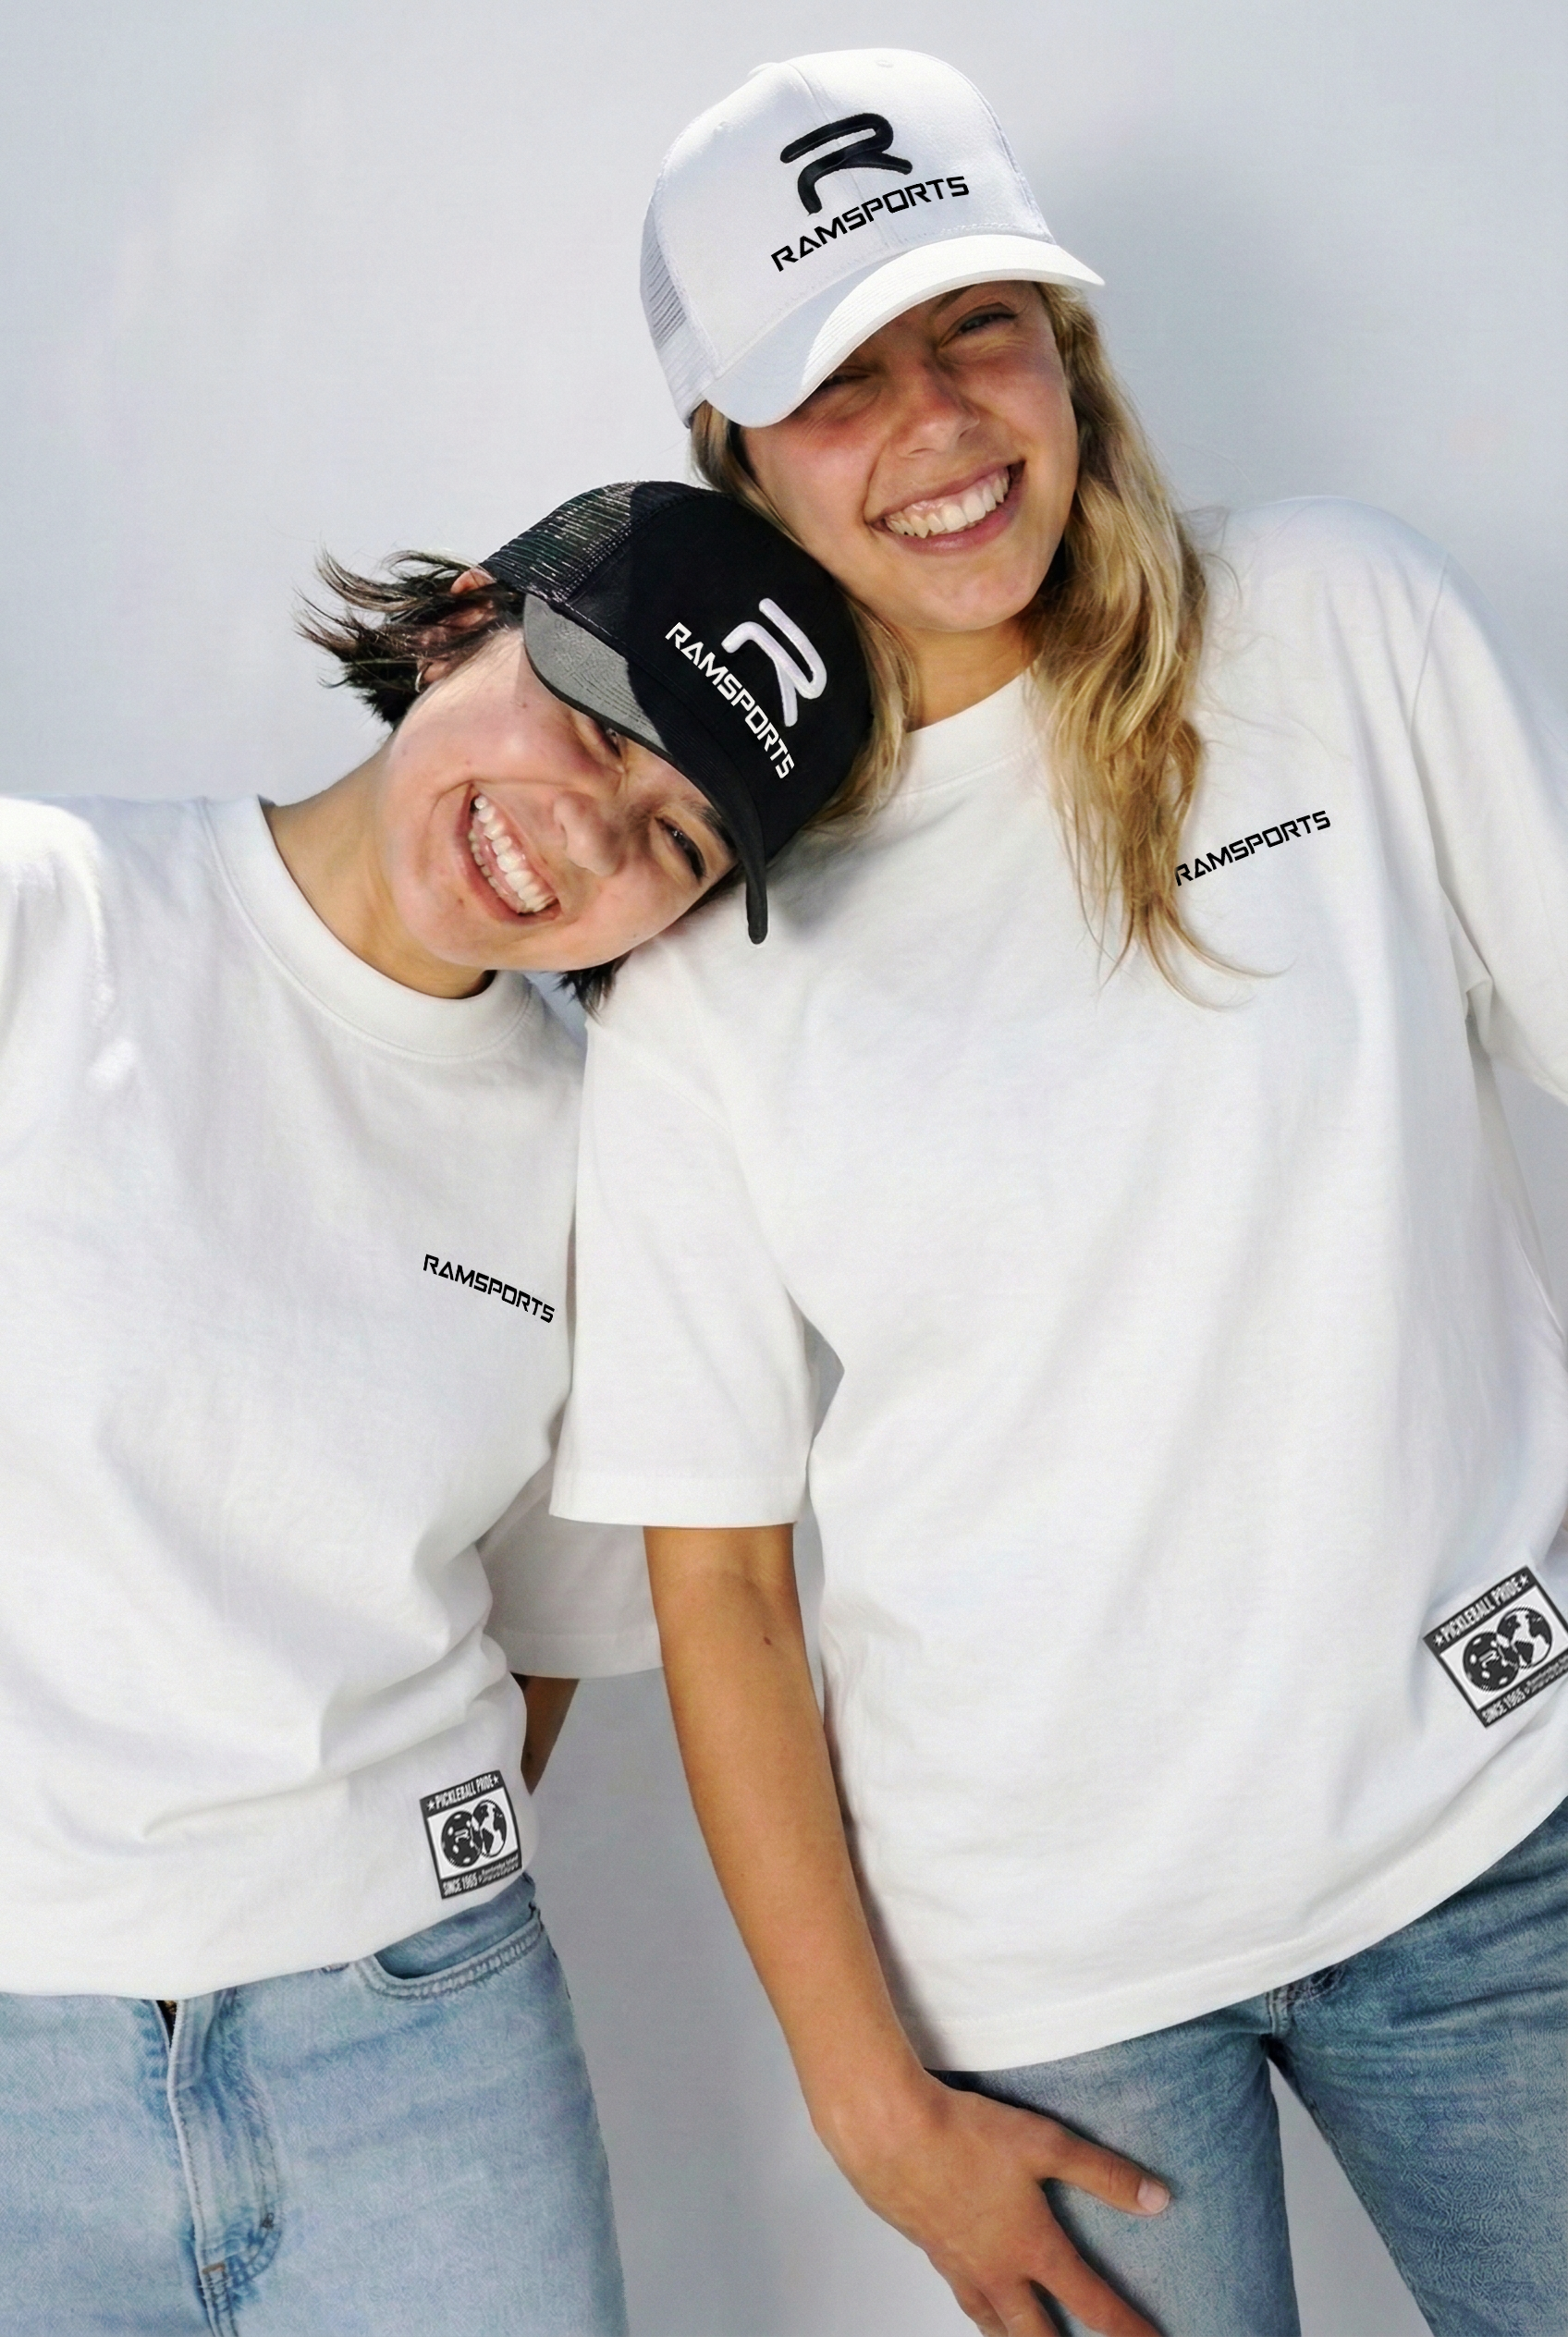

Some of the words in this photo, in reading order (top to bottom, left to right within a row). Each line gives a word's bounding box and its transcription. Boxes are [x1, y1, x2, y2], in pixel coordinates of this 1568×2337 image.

[770, 176, 970, 273] RAMSPORTS
[665, 621, 795, 779] RAMSPORTS
[1174, 810, 1331, 887] RAMSPORTS
[423, 1254, 556, 1324] RAMSPORTS
[1439, 1597, 1495, 1642] PICKLEBALL
[1491, 1576, 1522, 1606] PRIDE
[435, 1781, 477, 1809] PICKLEBALL
[476, 1774, 495, 1793] PRIDE
